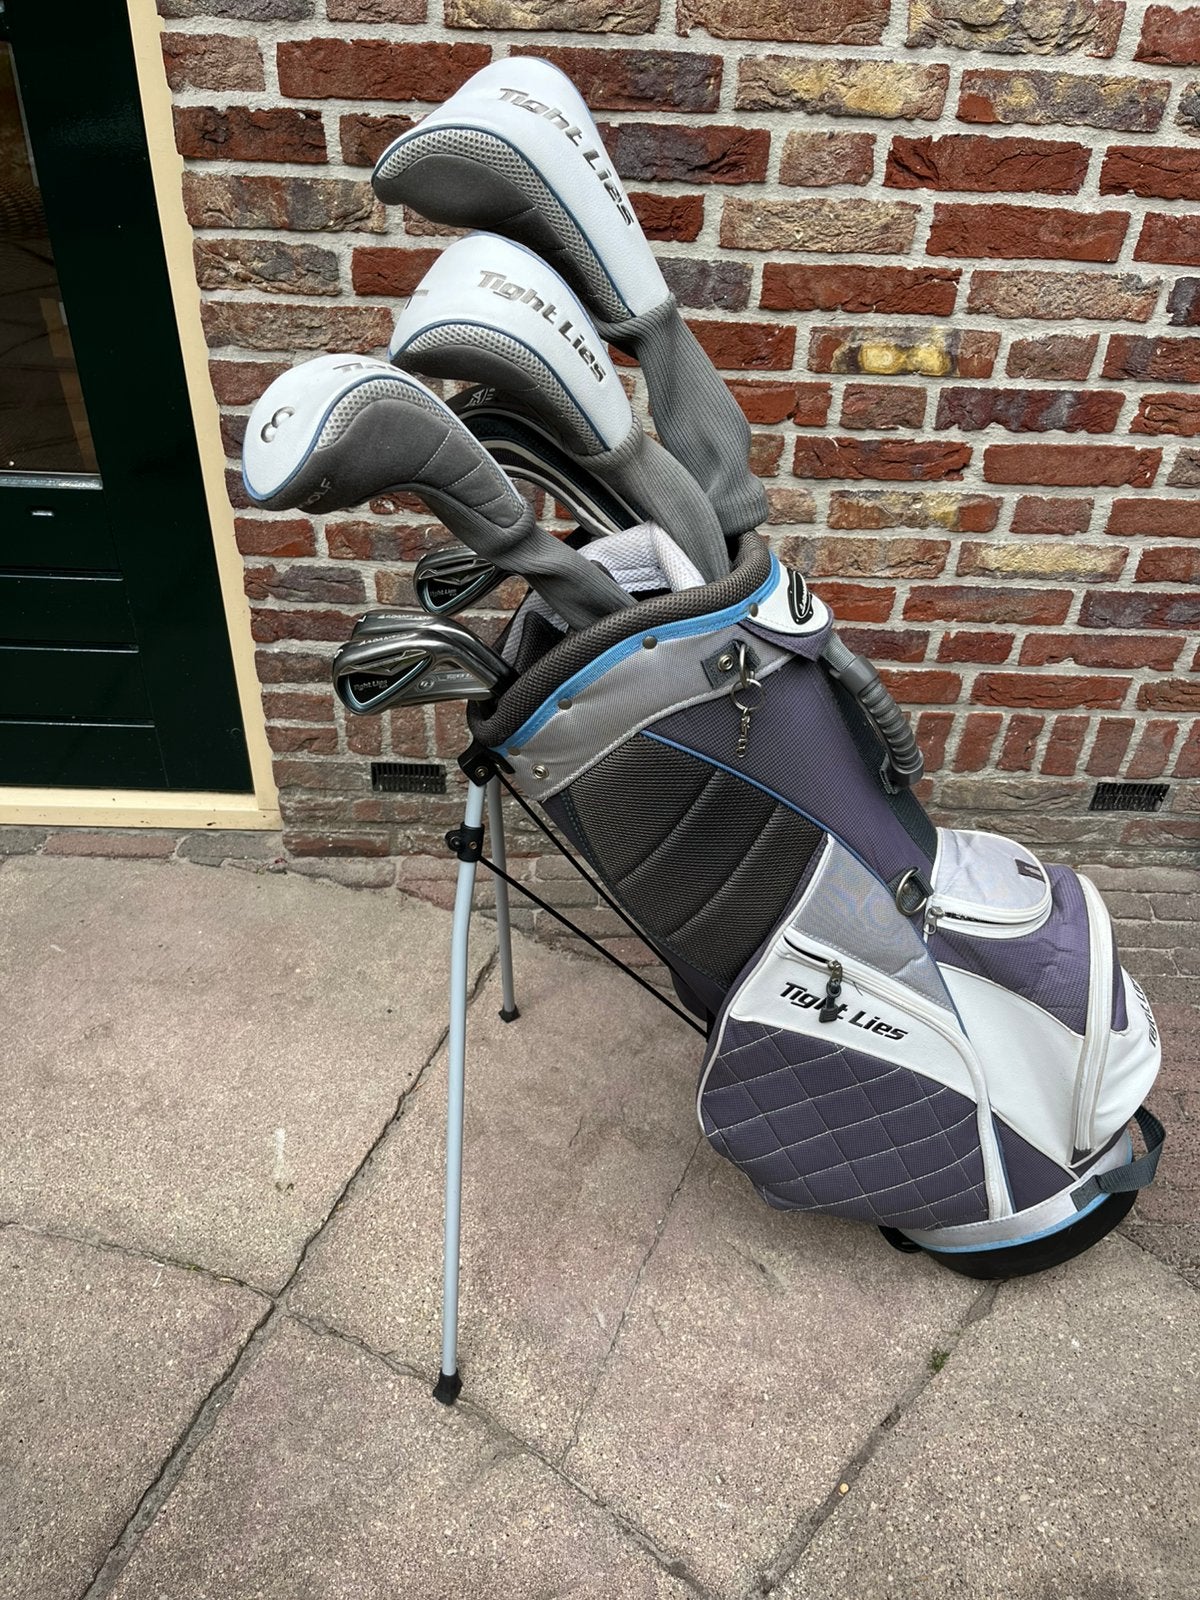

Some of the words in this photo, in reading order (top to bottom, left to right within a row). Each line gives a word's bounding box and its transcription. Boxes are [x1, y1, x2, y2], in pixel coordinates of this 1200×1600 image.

[499, 87, 584, 147] Tight
[582, 148, 634, 226] Lies
[476, 270, 558, 324] Tight
[558, 320, 607, 383] Lies
[848, 1010, 909, 1041] Lies
